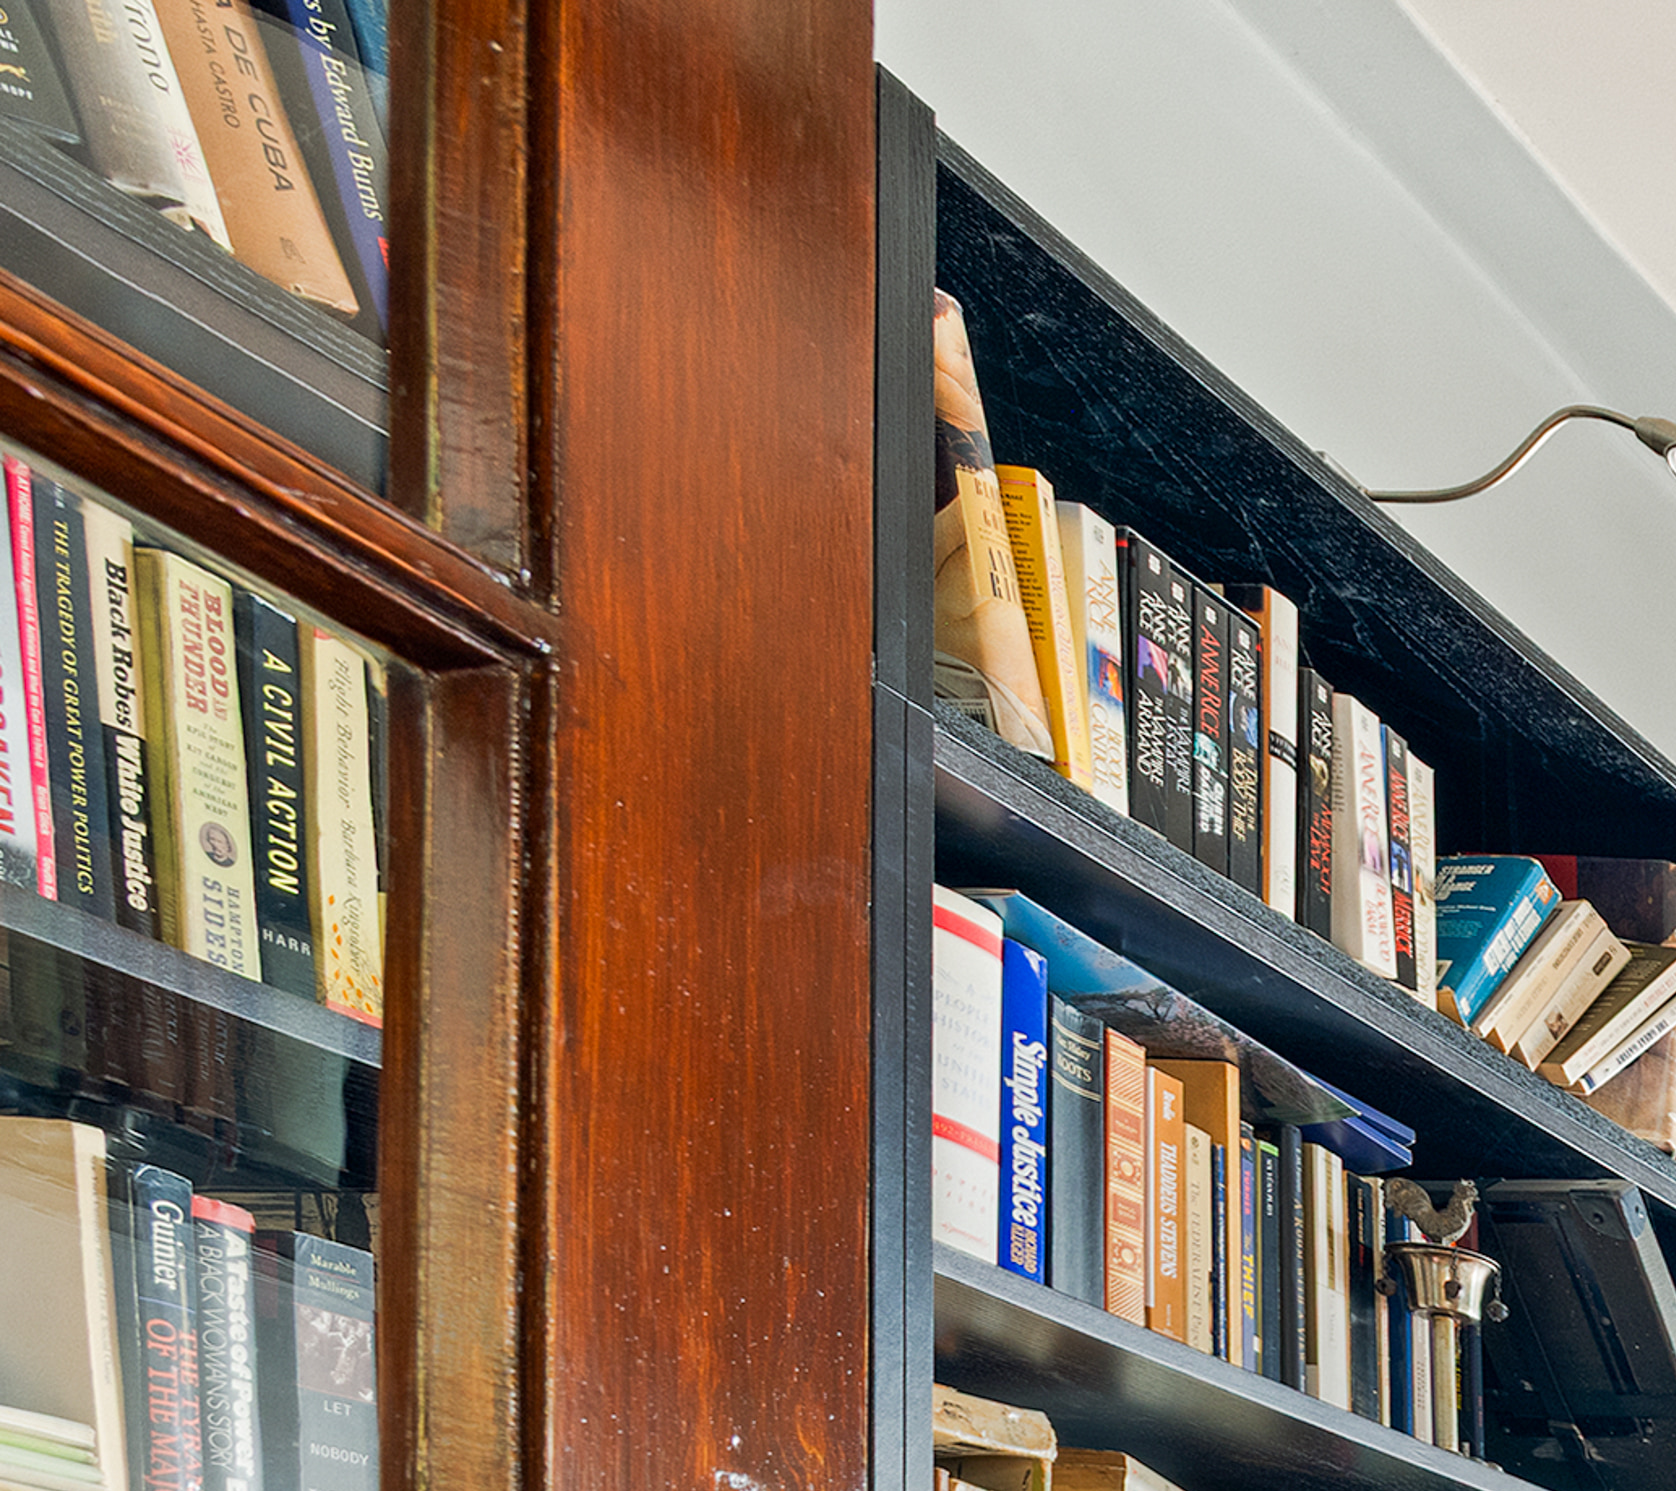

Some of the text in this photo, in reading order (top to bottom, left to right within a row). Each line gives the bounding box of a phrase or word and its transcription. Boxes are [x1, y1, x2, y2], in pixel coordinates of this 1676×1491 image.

[225, 25, 295, 192] DE CUBA
[306, 16, 385, 222] by Edward Burns
[53, 519, 69, 562] THE
[55, 562, 79, 648] TRAGEDY
[1097, 559, 1116, 636] ANNE
[1138, 588, 1153, 631] RICE
[1151, 591, 1167, 646] ANNE
[1175, 603, 1192, 657] ANNE
[61, 649, 80, 679] OF
[104, 557, 136, 729] Black Robes
[178, 579, 209, 717] THUNDER
[1200, 623, 1221, 739] ANNE RICE
[1230, 647, 1244, 688] RICE
[1241, 650, 1258, 702] ANNE
[63, 679, 83, 730] GREAT
[328, 656, 358, 811] Flight Behavior
[1137, 688, 1153, 777] ARMAND
[1320, 711, 1332, 760] ANNE
[66, 731, 88, 810] POWER
[262, 649, 301, 895] A CIVIL ACTION
[1150, 706, 1167, 789] VAMPIRE
[116, 734, 150, 912] White Justice
[1390, 764, 1409, 845] ANNE RICE
[71, 811, 95, 896] POLITICS
[202, 876, 229, 966] SIDES
[226, 886, 246, 974] HAMPTON
[339, 816, 366, 977] Barbara Kingsolver
[1394, 889, 1413, 959] MERRICK
[262, 927, 313, 957] HARR
[1055, 1052, 1094, 1084] ROOTS
[1011, 1030, 1048, 1228] Simple Justice
[149, 1197, 186, 1293] Guinier
[1158, 1142, 1178, 1280] THADDEUS STEVENS
[308, 1273, 361, 1301] Mullings
[309, 1252, 358, 1278] Marable
[145, 1317, 177, 1363] OF
[223, 1228, 256, 1476] A Taste of Power
[148, 1368, 178, 1424] THE
[323, 1399, 354, 1417] LET
[309, 1442, 371, 1466] NOBODY
